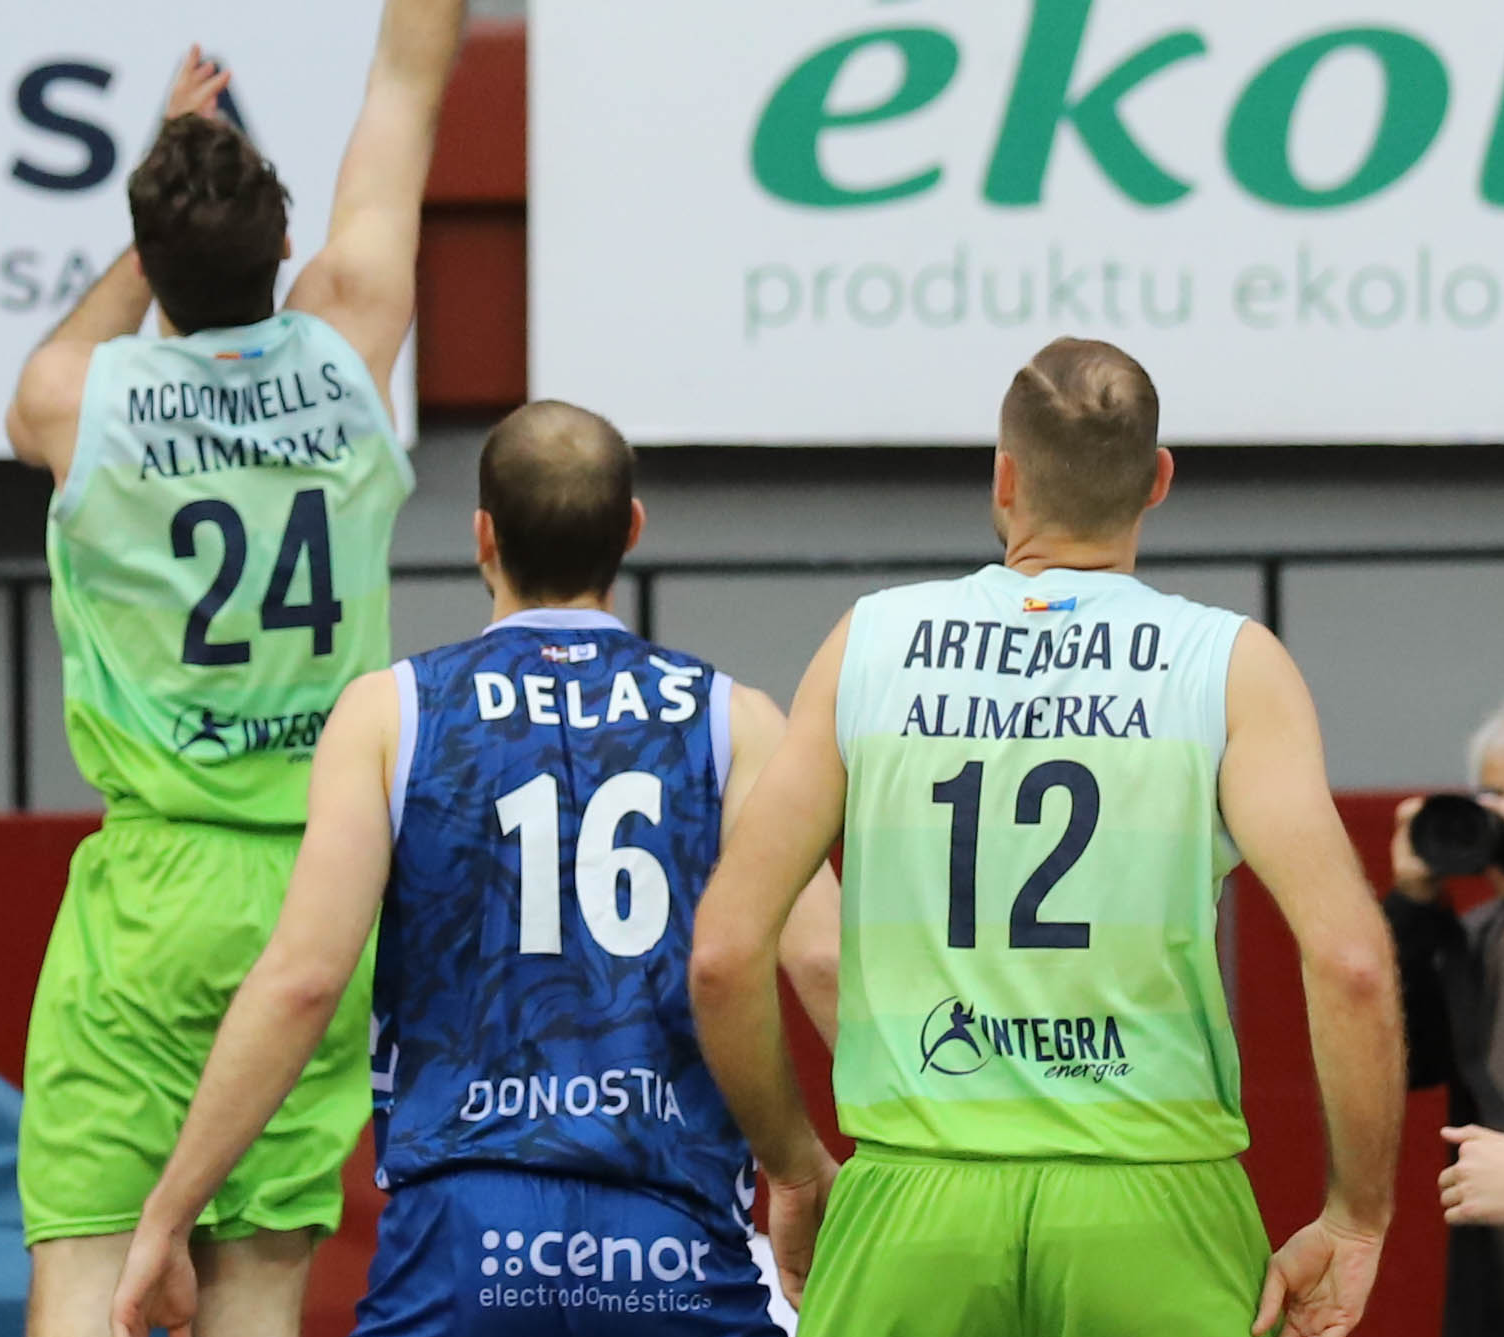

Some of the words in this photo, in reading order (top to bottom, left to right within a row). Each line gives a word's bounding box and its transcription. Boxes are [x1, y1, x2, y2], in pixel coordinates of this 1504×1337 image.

[744, 247, 1192, 345] produktu
[129, 372, 317, 425] MCDONNELL
[321, 362, 351, 401] S.
[140, 422, 355, 481] ALIMERKA
[171, 488, 342, 666] 24
[904, 619, 1111, 678] ARTEAGA
[1129, 623, 1169, 671] O.
[901, 694, 1151, 739] ALIMERKA
[495, 770, 670, 957] 16
[932, 759, 1101, 950] 12
[980, 1015, 1126, 1062] INTEGRA
[460, 1068, 685, 1125] DONOSTIA
[529, 1230, 710, 1282] cenor
[479, 1283, 712, 1313] electrodomésticos
